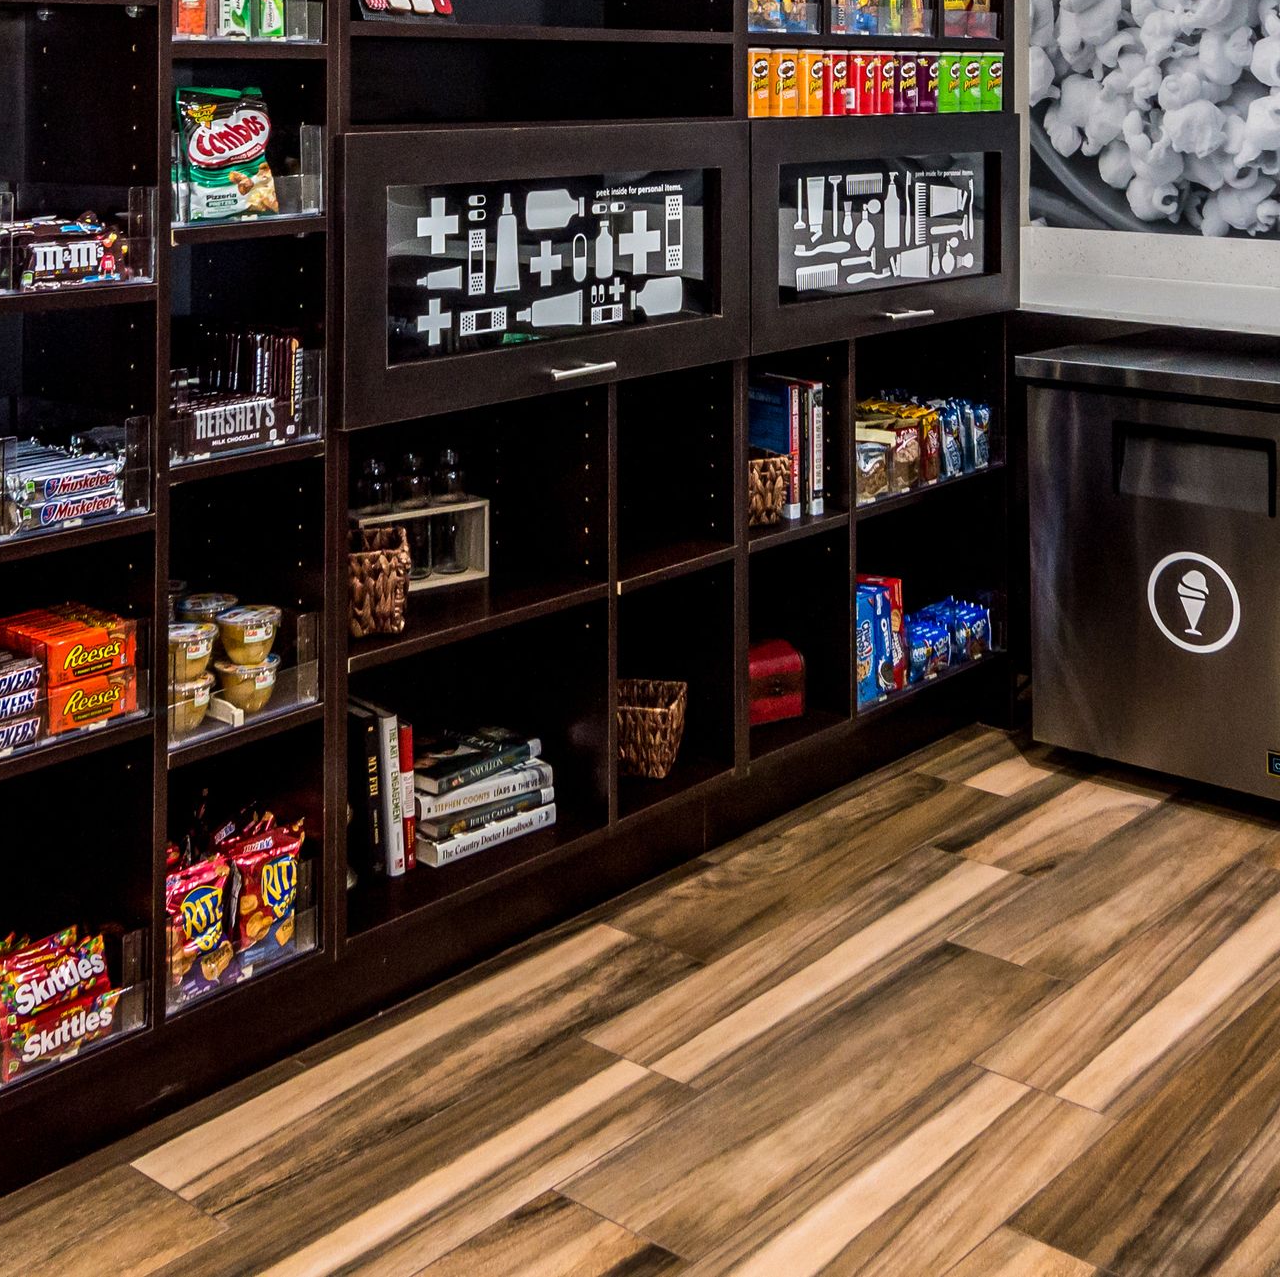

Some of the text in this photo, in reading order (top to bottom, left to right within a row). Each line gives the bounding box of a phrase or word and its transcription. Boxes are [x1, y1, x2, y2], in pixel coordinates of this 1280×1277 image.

[206, 192, 237, 201] Pizzeria
[596, 187, 610, 198] peek
[611, 187, 628, 196] inside
[628, 185, 638, 194] for
[637, 184, 664, 195] personal
[195, 401, 276, 440] HERSHEY'S
[211, 432, 260, 447] MILK CHOCOLATE
[63, 641, 122, 671] Reese's
[63, 685, 121, 716] Reese's
[368, 755, 379, 796] MY FBI
[389, 727, 402, 825] THE ART ENGAGEMENT
[435, 798, 462, 813] STEPHEN
[462, 791, 491, 805] COONTS
[493, 785, 511, 798] LIARS
[470, 813, 491, 827] JULIUS
[442, 819, 534, 860] The Country Doctor Handbook
[15, 953, 105, 1015] Skittles
[22, 1006, 113, 1063] Skittles
